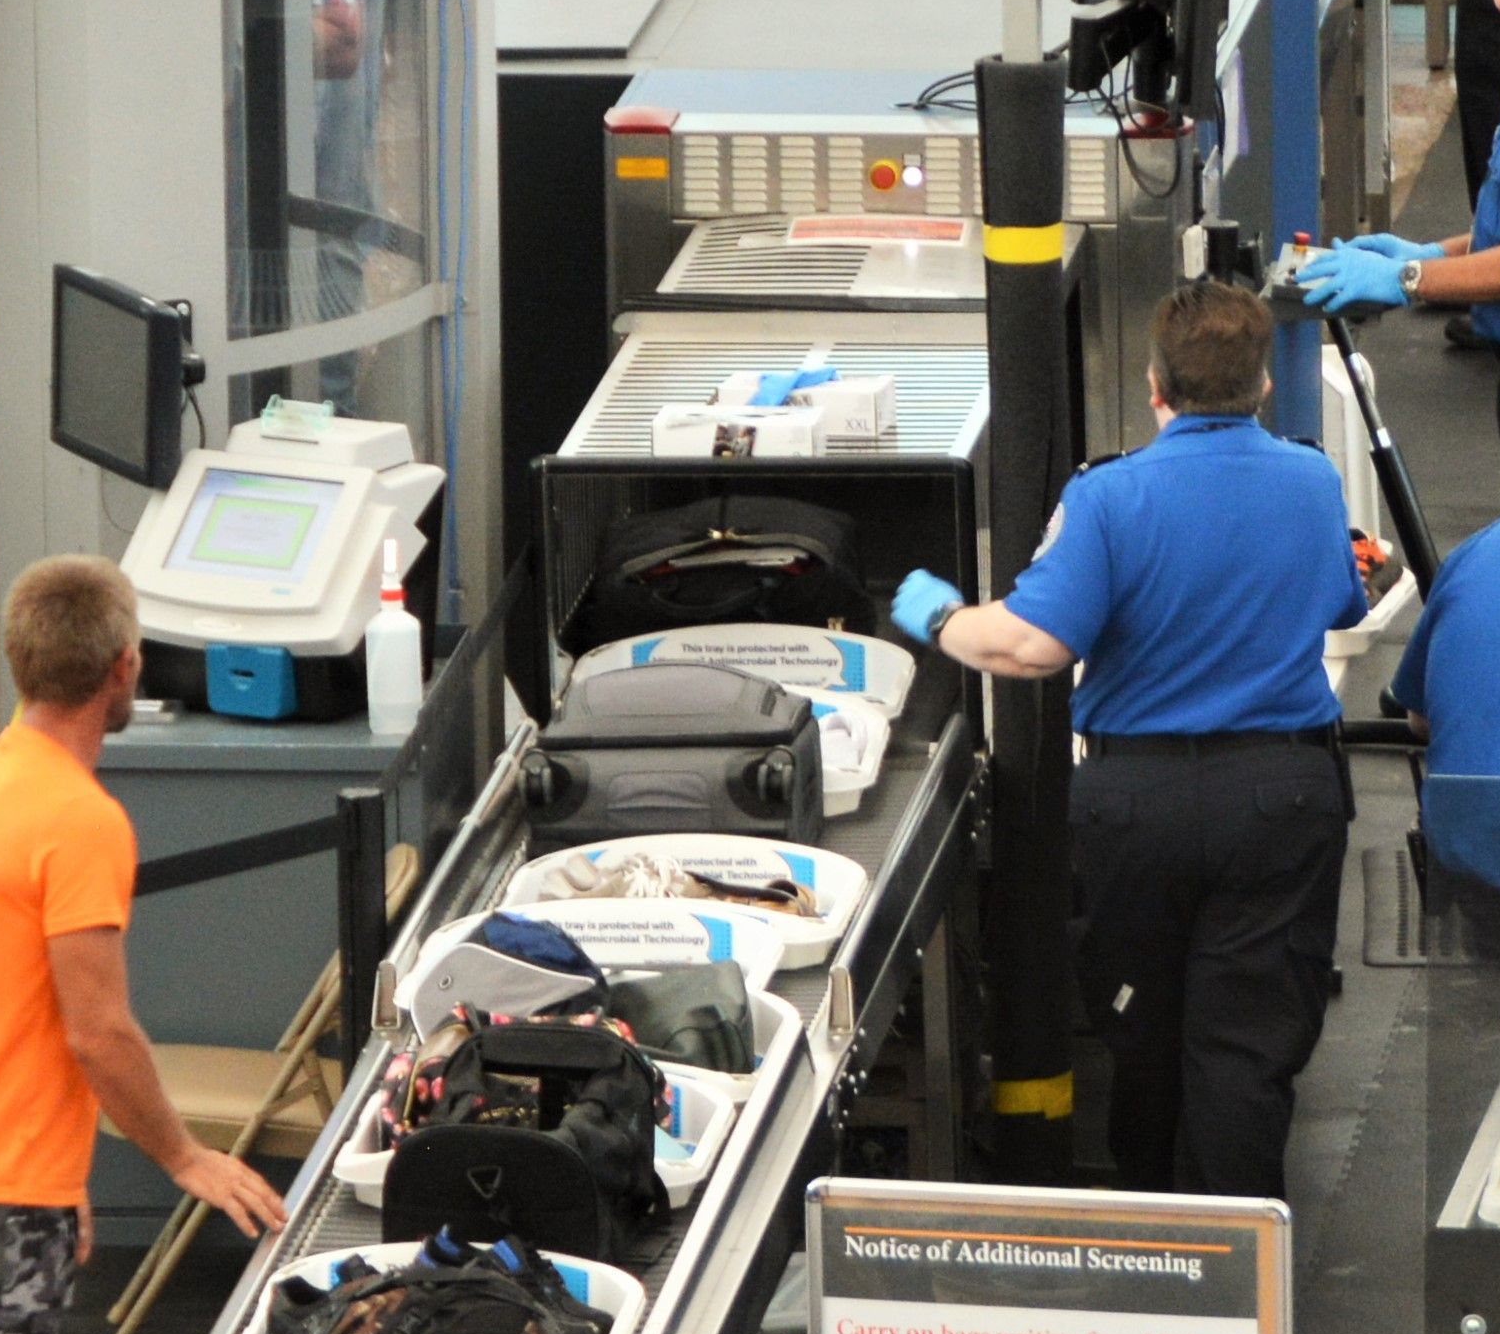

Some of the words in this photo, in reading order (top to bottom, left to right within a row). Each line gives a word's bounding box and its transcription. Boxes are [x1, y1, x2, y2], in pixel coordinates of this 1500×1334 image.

[845, 418, 871, 432] XXL
[681, 643, 703, 653] This
[705, 643, 727, 655] tray
[737, 643, 788, 656] protected
[788, 643, 810, 653] with
[780, 656, 839, 668] Technology
[681, 856, 733, 868] protected
[734, 856, 757, 867] with
[597, 920, 649, 933] protected
[651, 920, 674, 931] with
[643, 934, 705, 947] Technology
[844, 1234, 922, 1261] Notice
[925, 1239, 953, 1262] of
[956, 1243, 1082, 1268] Additional
[1086, 1247, 1203, 1279] Screening
